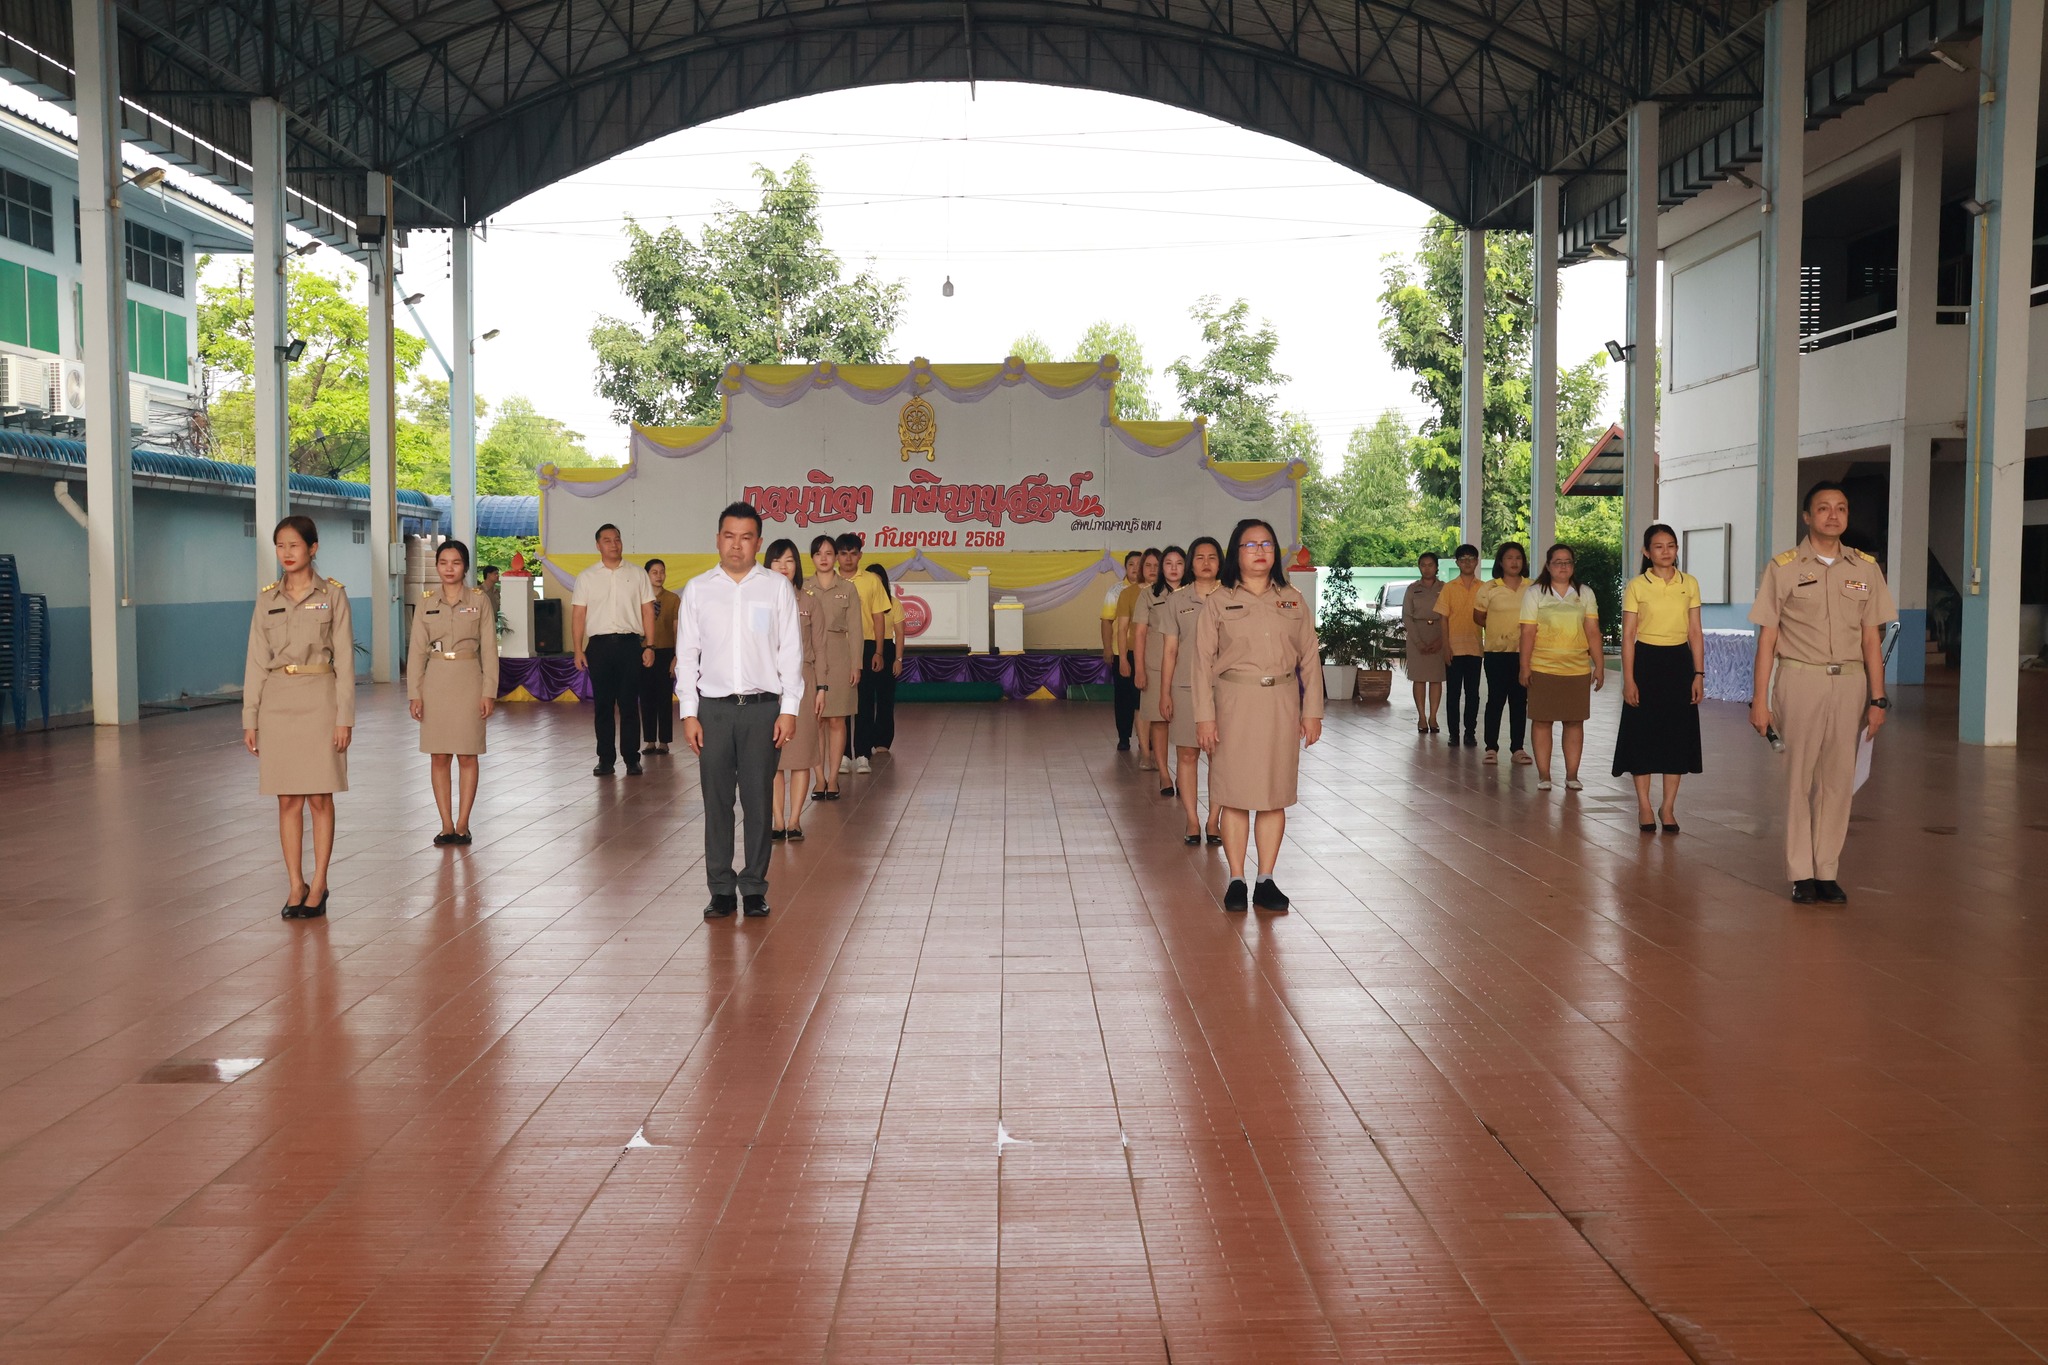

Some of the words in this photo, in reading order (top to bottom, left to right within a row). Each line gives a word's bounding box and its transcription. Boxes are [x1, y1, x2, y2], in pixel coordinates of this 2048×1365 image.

[874, 525, 957, 547] กันยายน
[964, 531, 1006, 547] 2568
